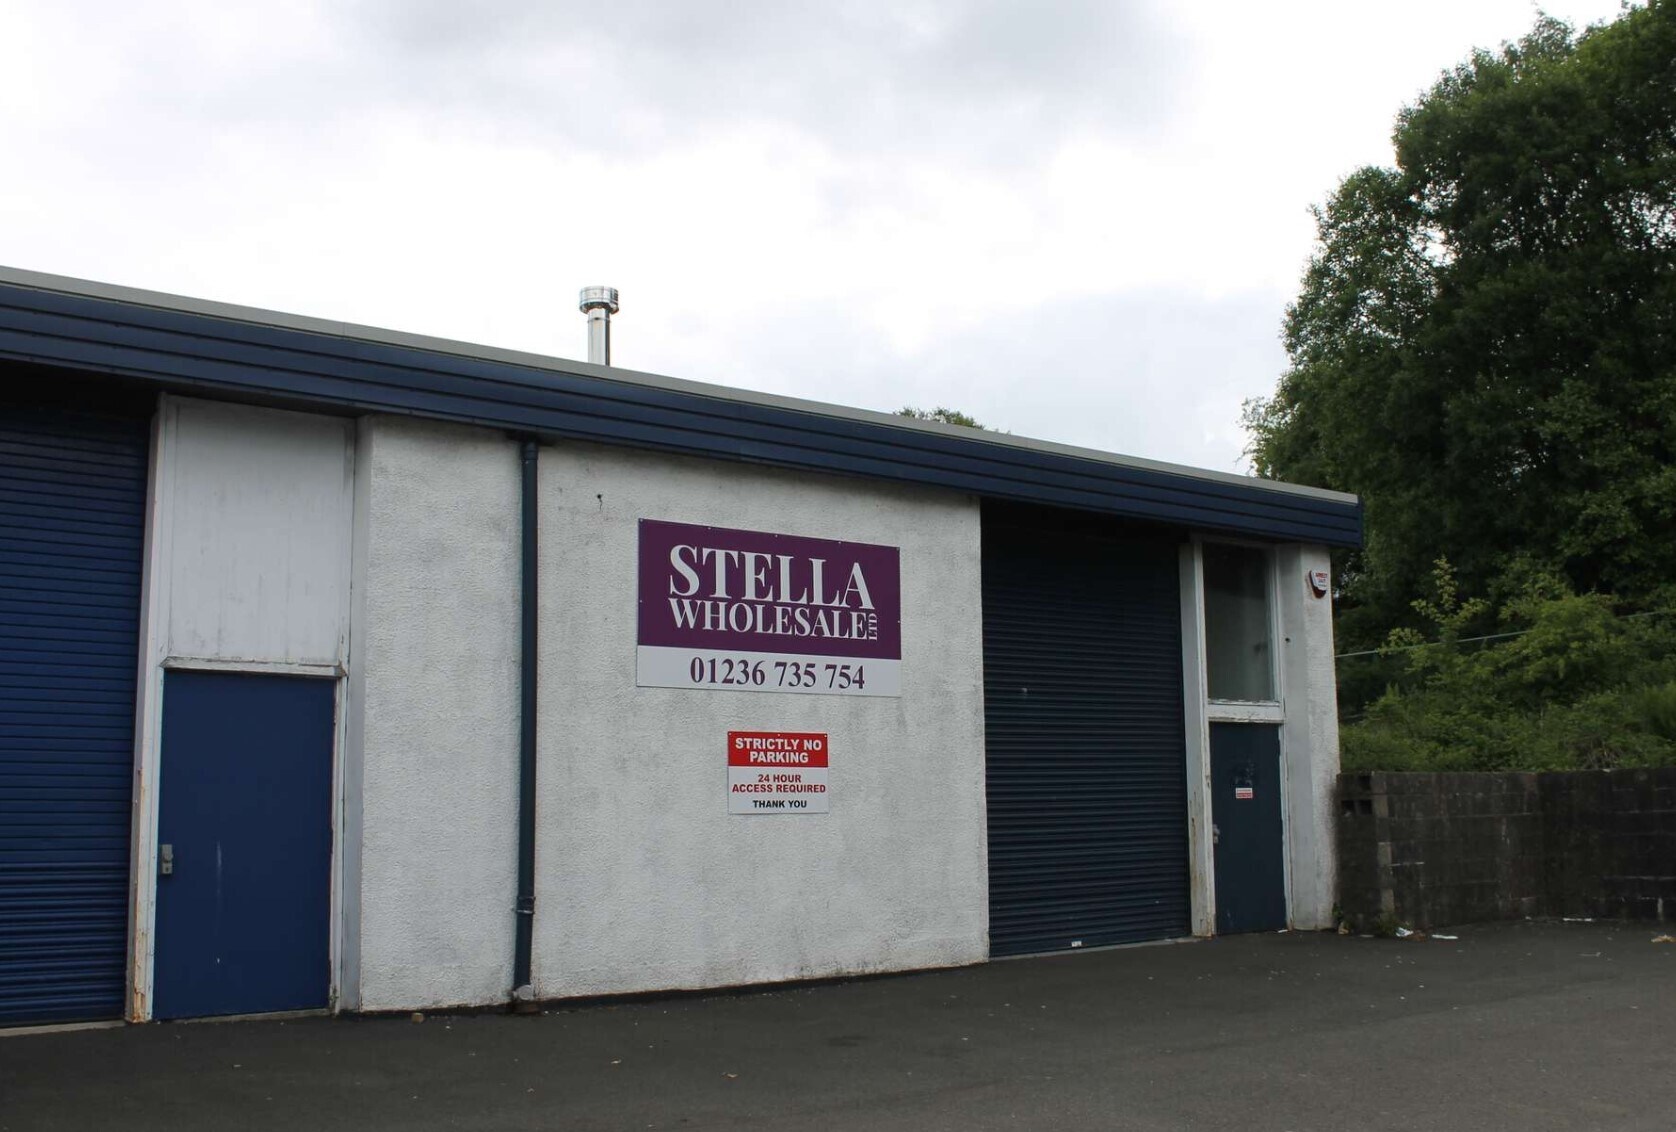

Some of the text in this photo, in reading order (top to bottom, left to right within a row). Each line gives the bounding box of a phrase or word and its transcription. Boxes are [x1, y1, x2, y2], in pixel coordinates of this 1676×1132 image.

[669, 544, 875, 610] STELLA
[668, 597, 878, 641] WHOLESALE LTD
[690, 656, 865, 689] 01236 735 754
[735, 737, 822, 751] STRICTLY NO
[749, 751, 809, 763] PARKING
[758, 774, 801, 783] 24 HOUR
[732, 784, 826, 793] ACCESS REQUIRED
[753, 800, 807, 808] THANK YOU
